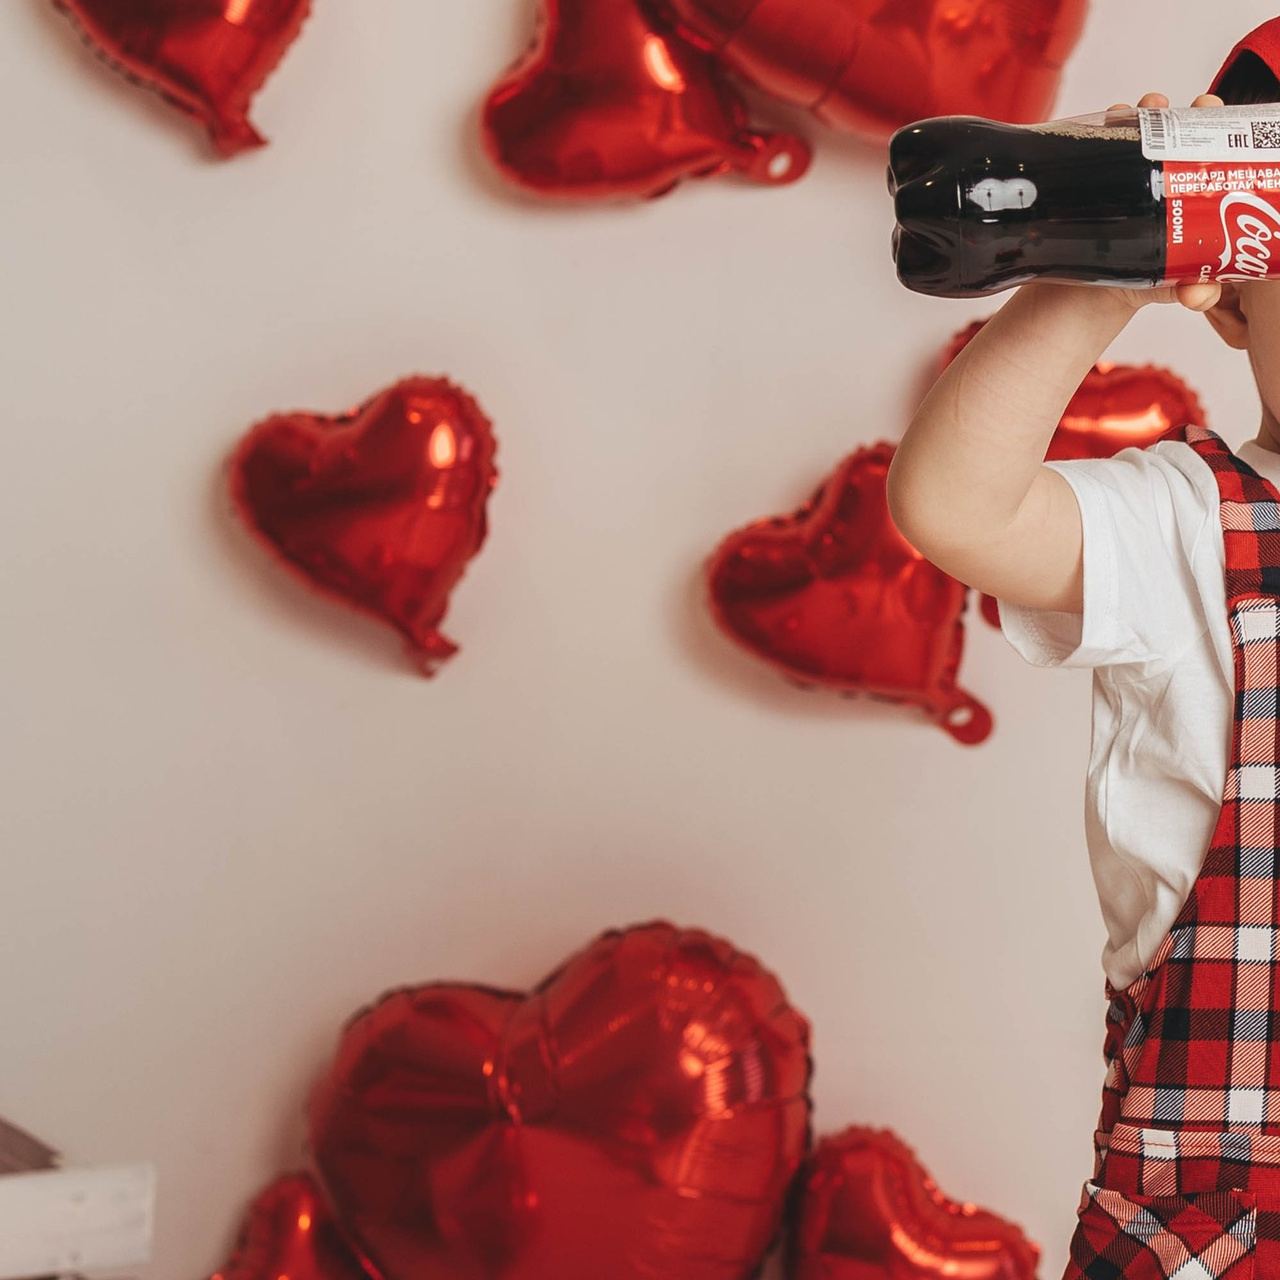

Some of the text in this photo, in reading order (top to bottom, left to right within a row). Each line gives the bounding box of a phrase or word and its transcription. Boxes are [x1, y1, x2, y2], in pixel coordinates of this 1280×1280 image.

[1169, 170, 1226, 183] КОРКАРД
[1170, 180, 1254, 194] ПЕРЕРАБОТАЙ
[1171, 199, 1184, 244] 500МЛ
